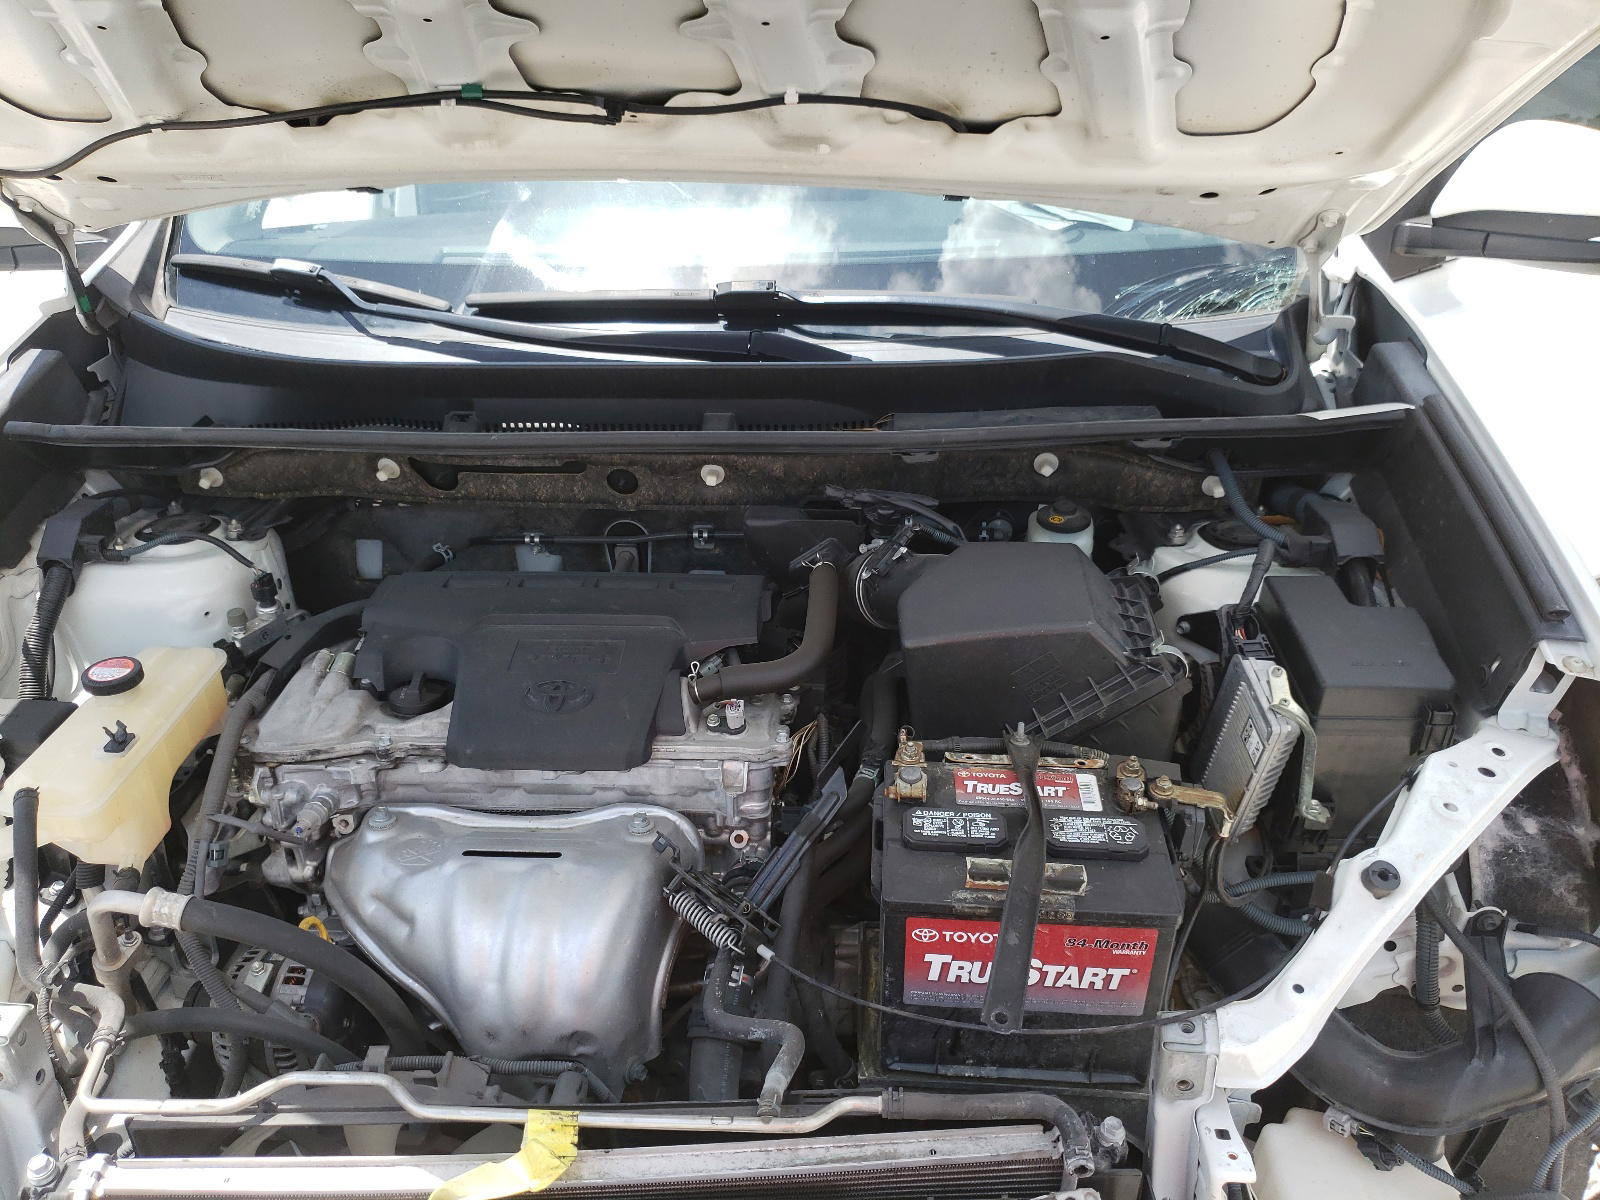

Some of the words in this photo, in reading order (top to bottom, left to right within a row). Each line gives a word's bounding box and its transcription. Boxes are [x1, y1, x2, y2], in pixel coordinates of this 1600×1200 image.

[964, 780, 1067, 797] TRUESART
[942, 931, 998, 944] TOYO
[1064, 938, 1149, 950] 84-Month
[923, 953, 1131, 990] TRUSTART
